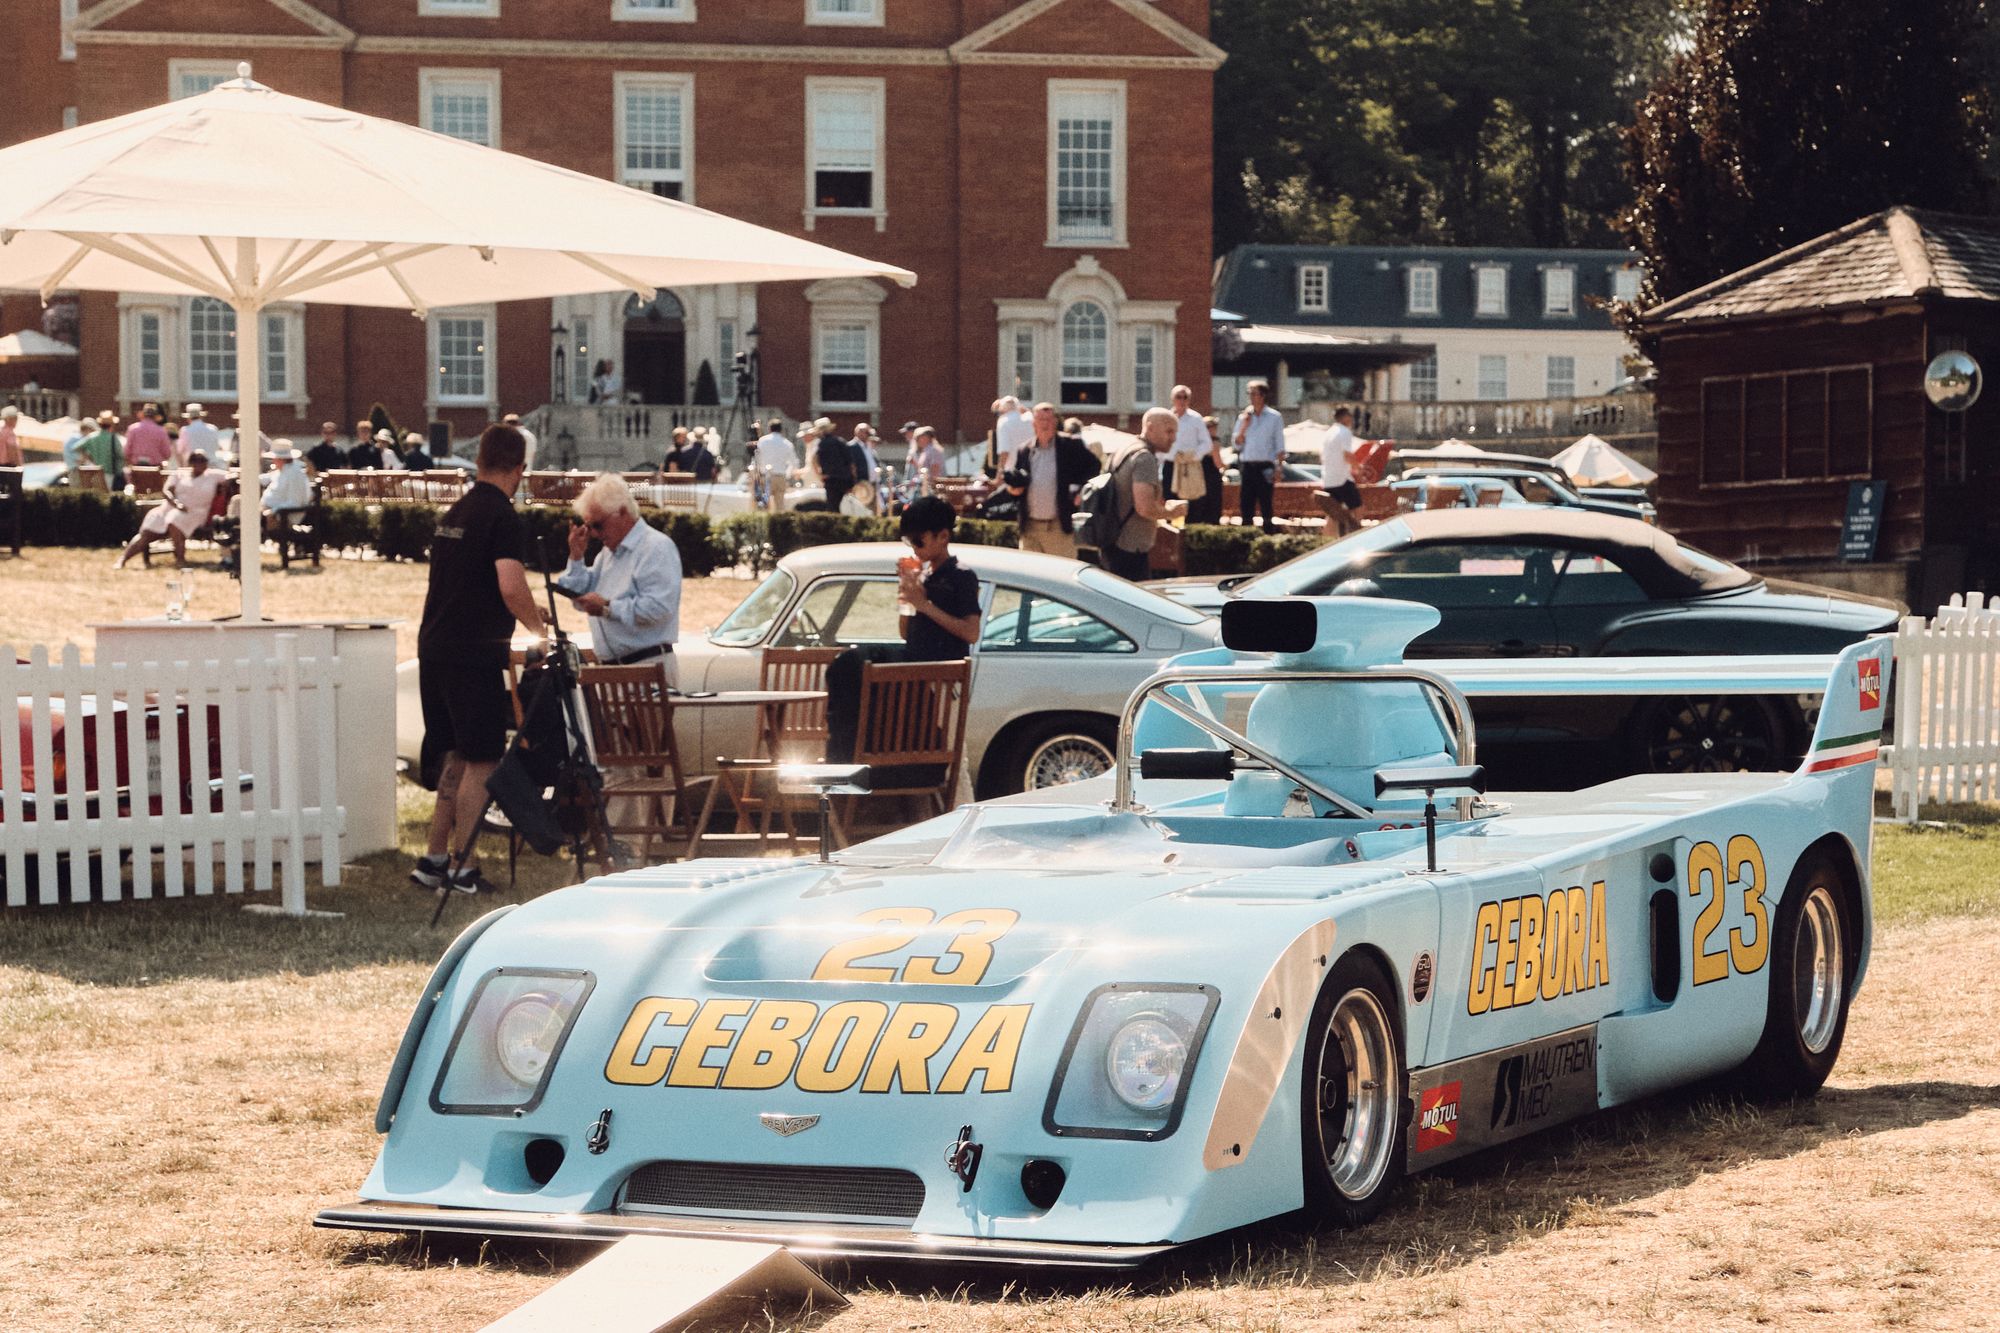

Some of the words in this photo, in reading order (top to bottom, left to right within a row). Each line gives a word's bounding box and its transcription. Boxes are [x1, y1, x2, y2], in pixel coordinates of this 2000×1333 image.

[811, 907, 1020, 985] 23
[1468, 881, 1610, 1016] CEBORA
[1687, 834, 1769, 986] 23
[603, 997, 1034, 1094] CEBORA
[1421, 1102, 1457, 1130] MOTUL
